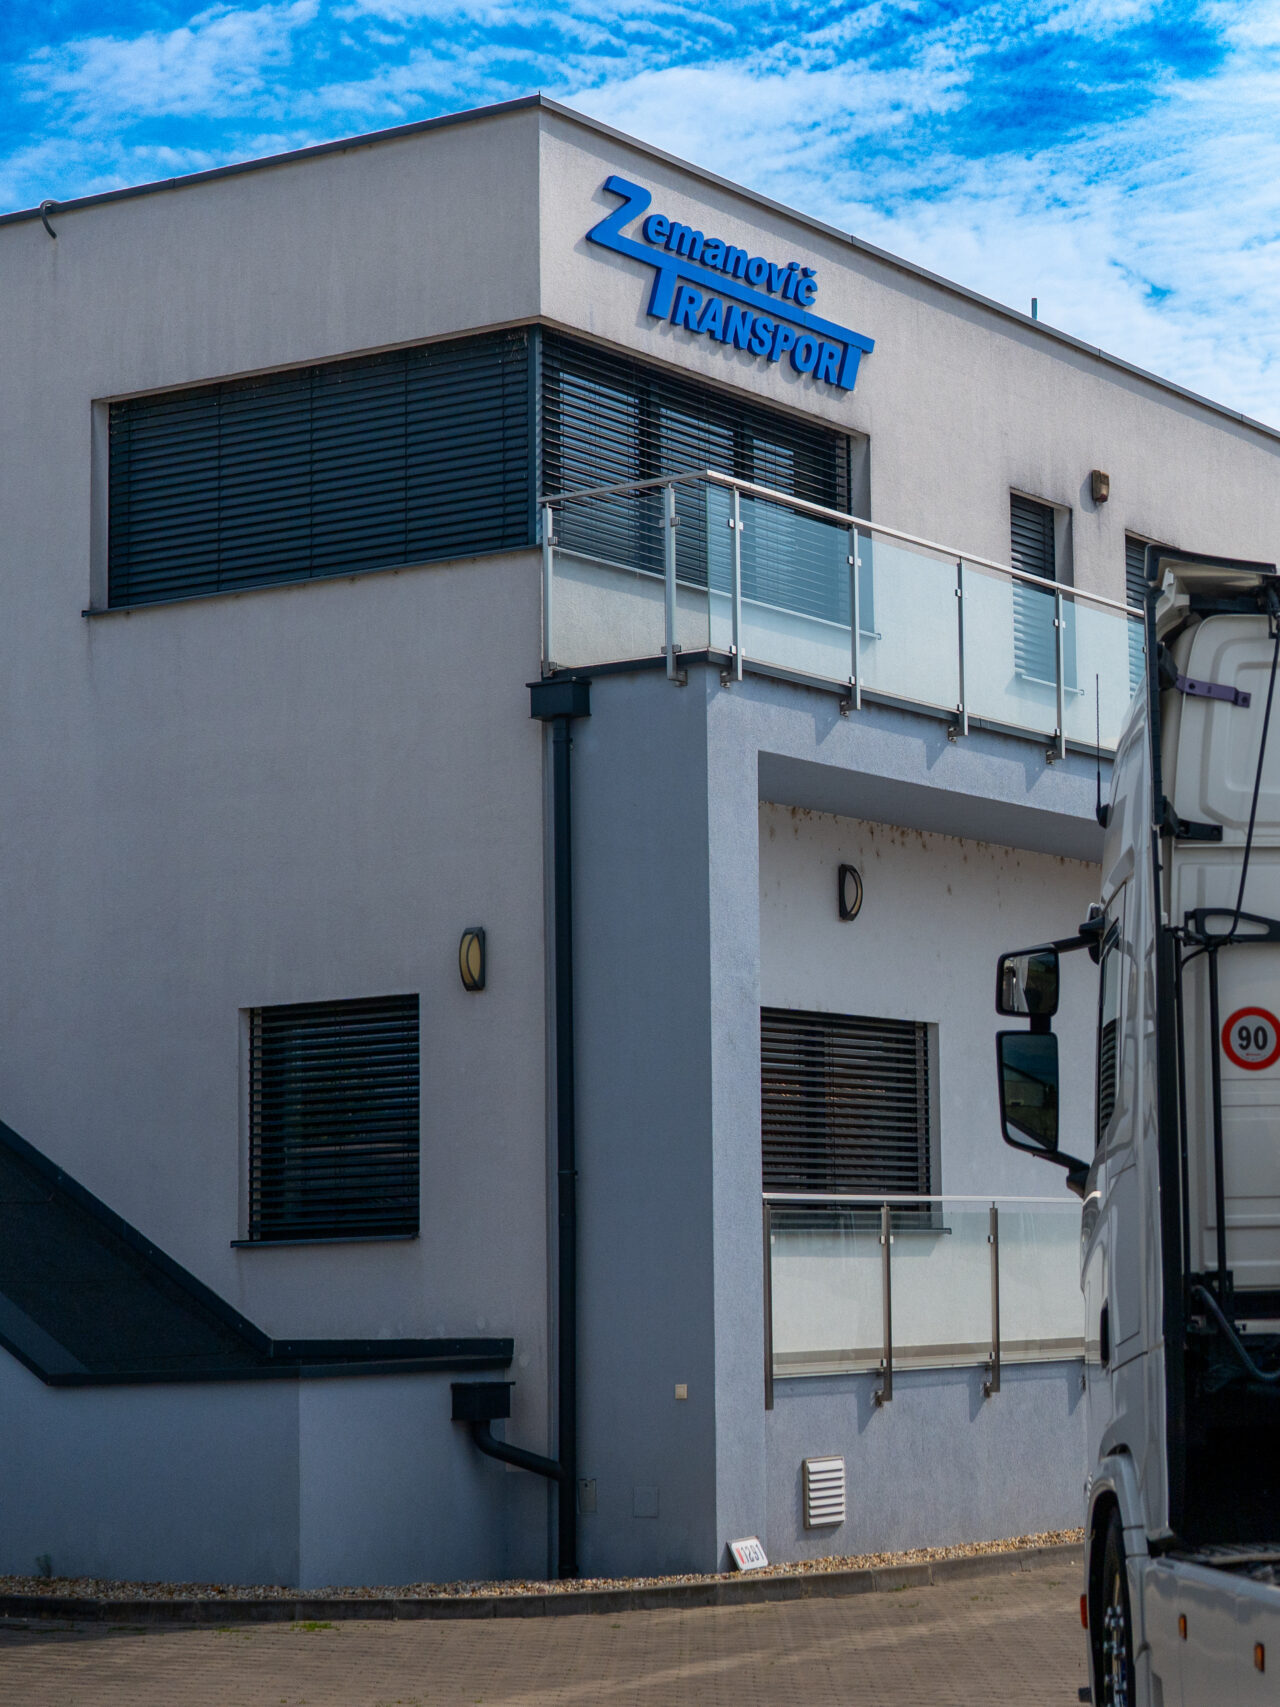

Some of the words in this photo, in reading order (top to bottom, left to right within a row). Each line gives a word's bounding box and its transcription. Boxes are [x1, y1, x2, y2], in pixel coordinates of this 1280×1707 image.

[586, 175, 818, 306] Zemanovič
[646, 258, 876, 391] TRANSPORT
[1238, 1025, 1268, 1050] 90
